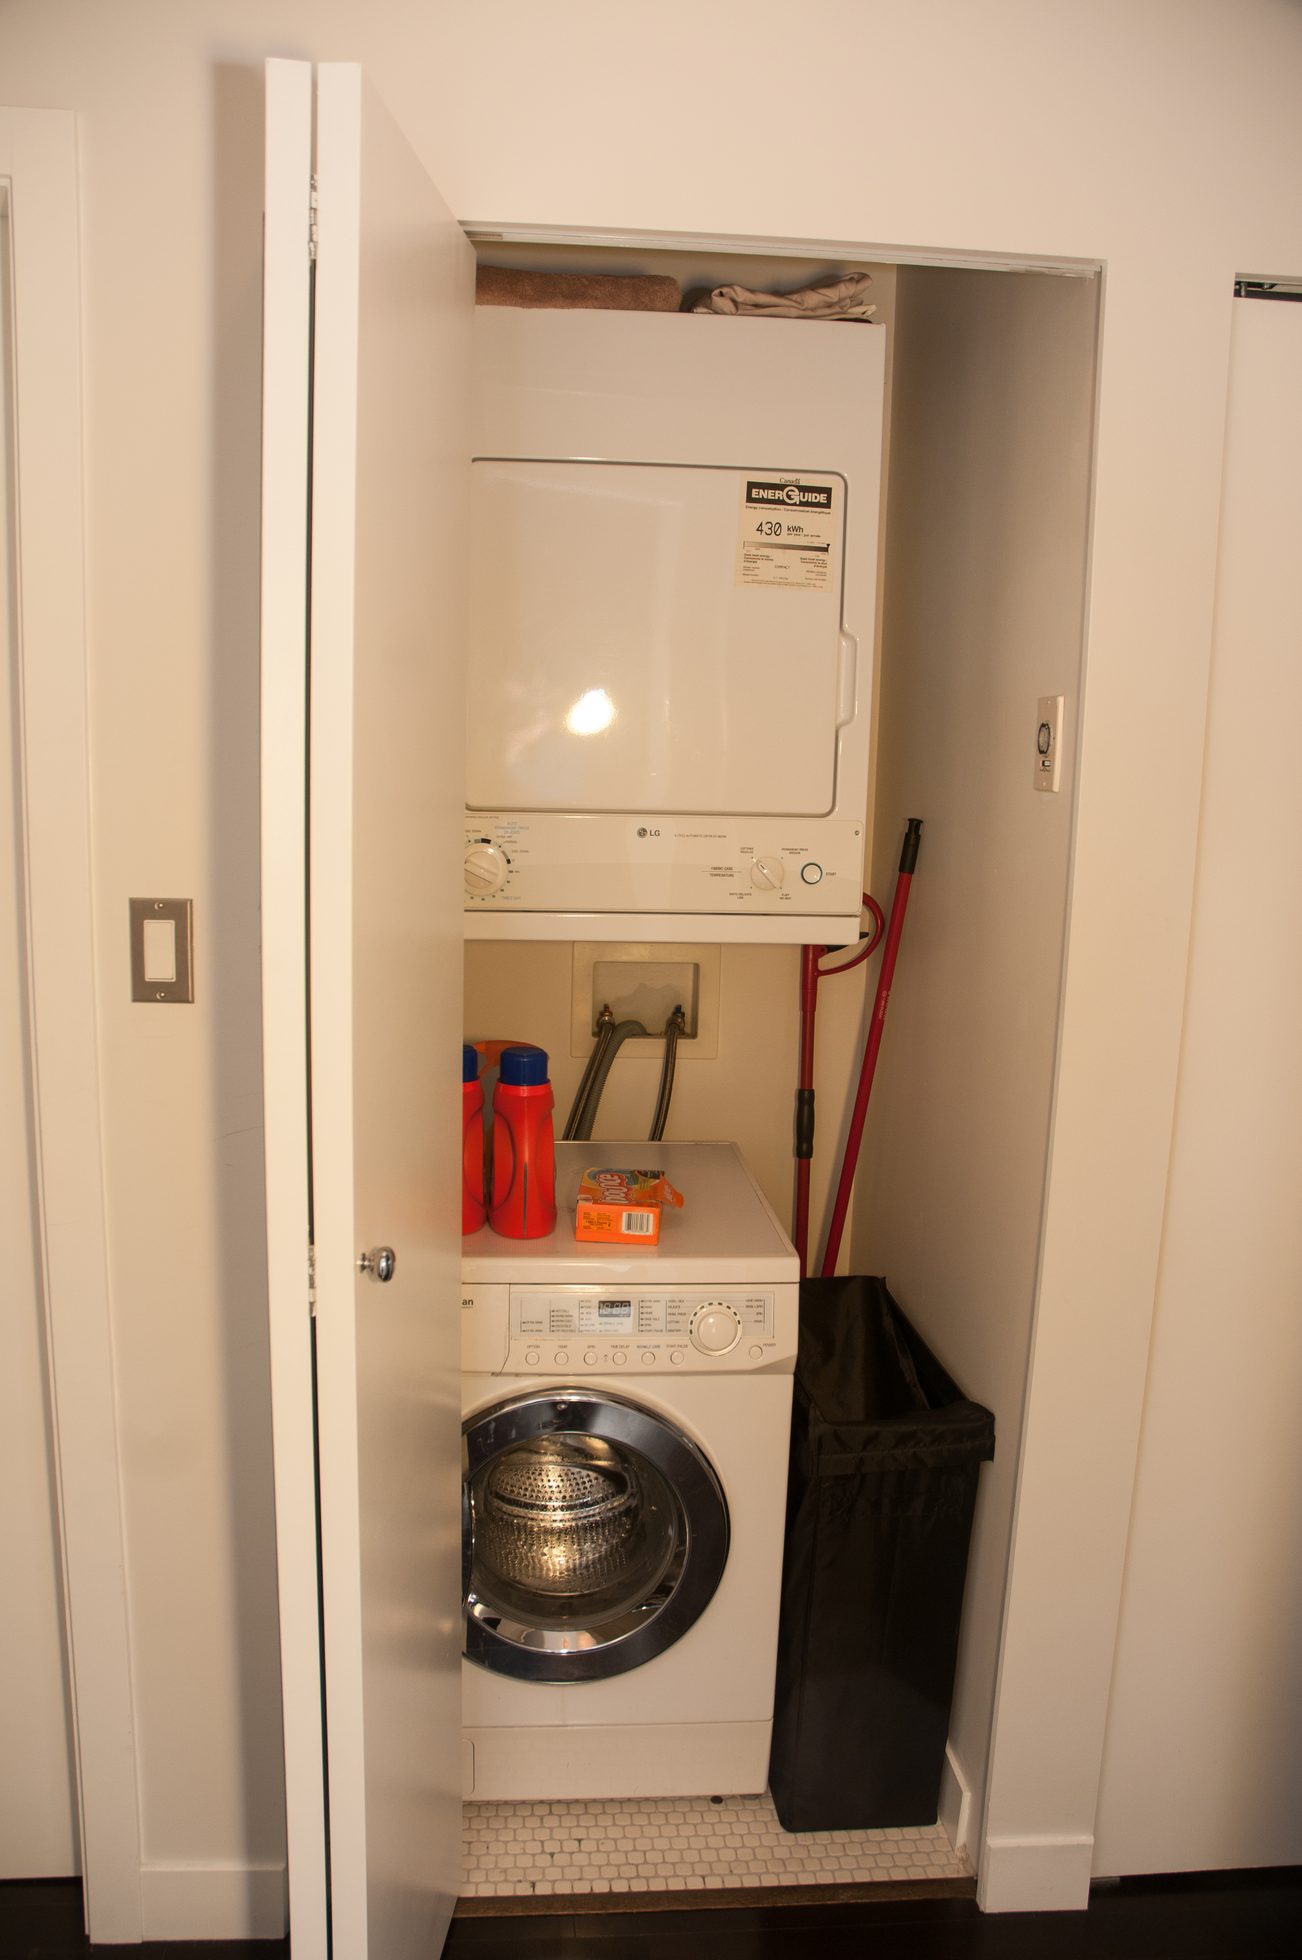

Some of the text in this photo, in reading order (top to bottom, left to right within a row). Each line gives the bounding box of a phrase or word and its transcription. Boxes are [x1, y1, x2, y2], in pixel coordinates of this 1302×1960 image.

[752, 486, 828, 504] ENERGUIDE
[756, 521, 782, 537] 430
[787, 525, 804, 533] kWh
[649, 829, 660, 837] LG
